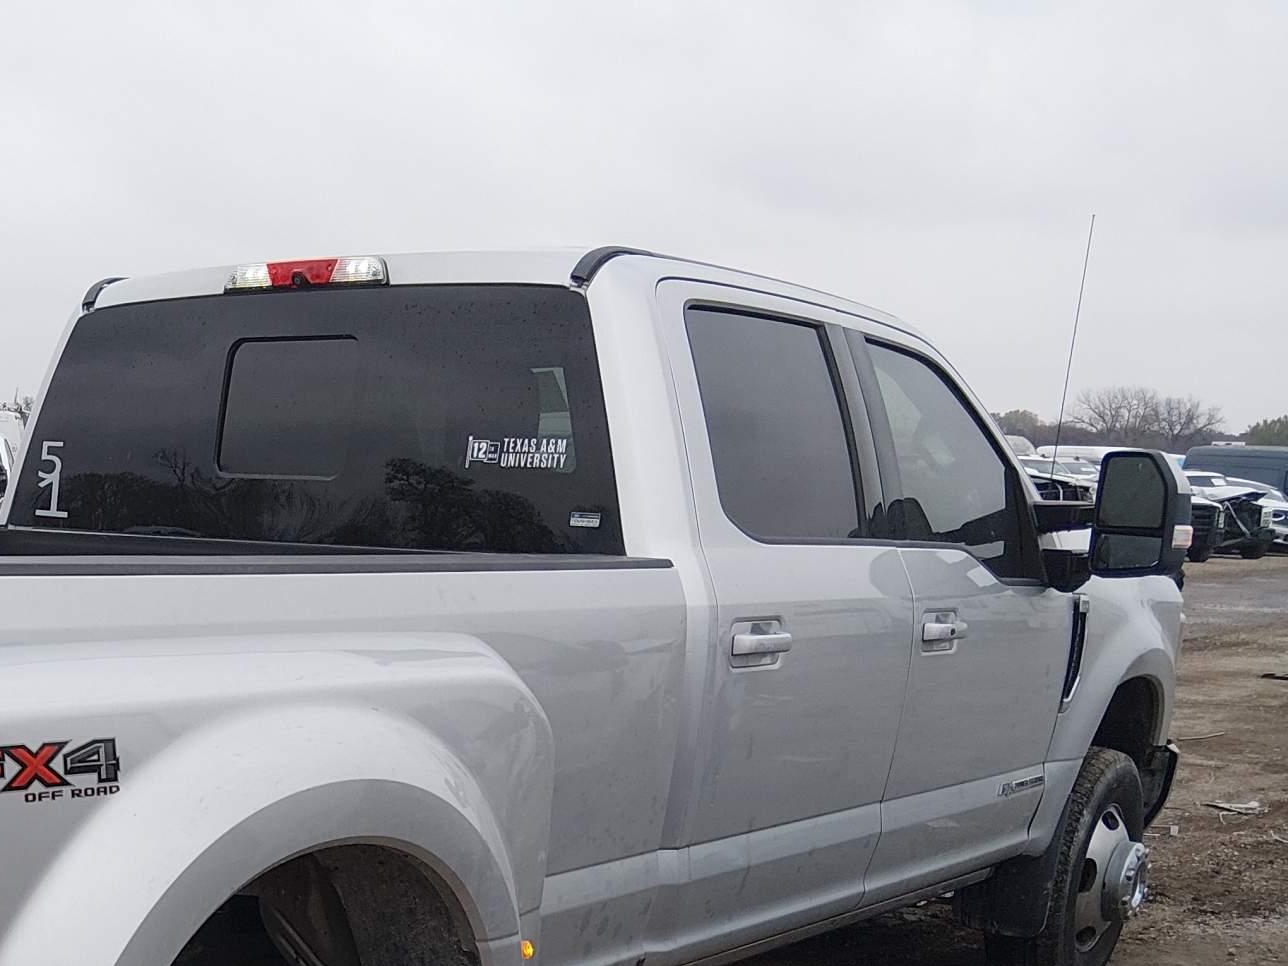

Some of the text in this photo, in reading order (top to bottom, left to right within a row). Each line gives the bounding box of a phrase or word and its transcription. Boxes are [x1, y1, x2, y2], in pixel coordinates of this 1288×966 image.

[473, 442, 488, 459] 12
[503, 437, 537, 453] TEXAS
[539, 438, 568, 453] A&M
[500, 453, 568, 469] UNIVERSITY
[24, 784, 121, 803] OFF ROAD
